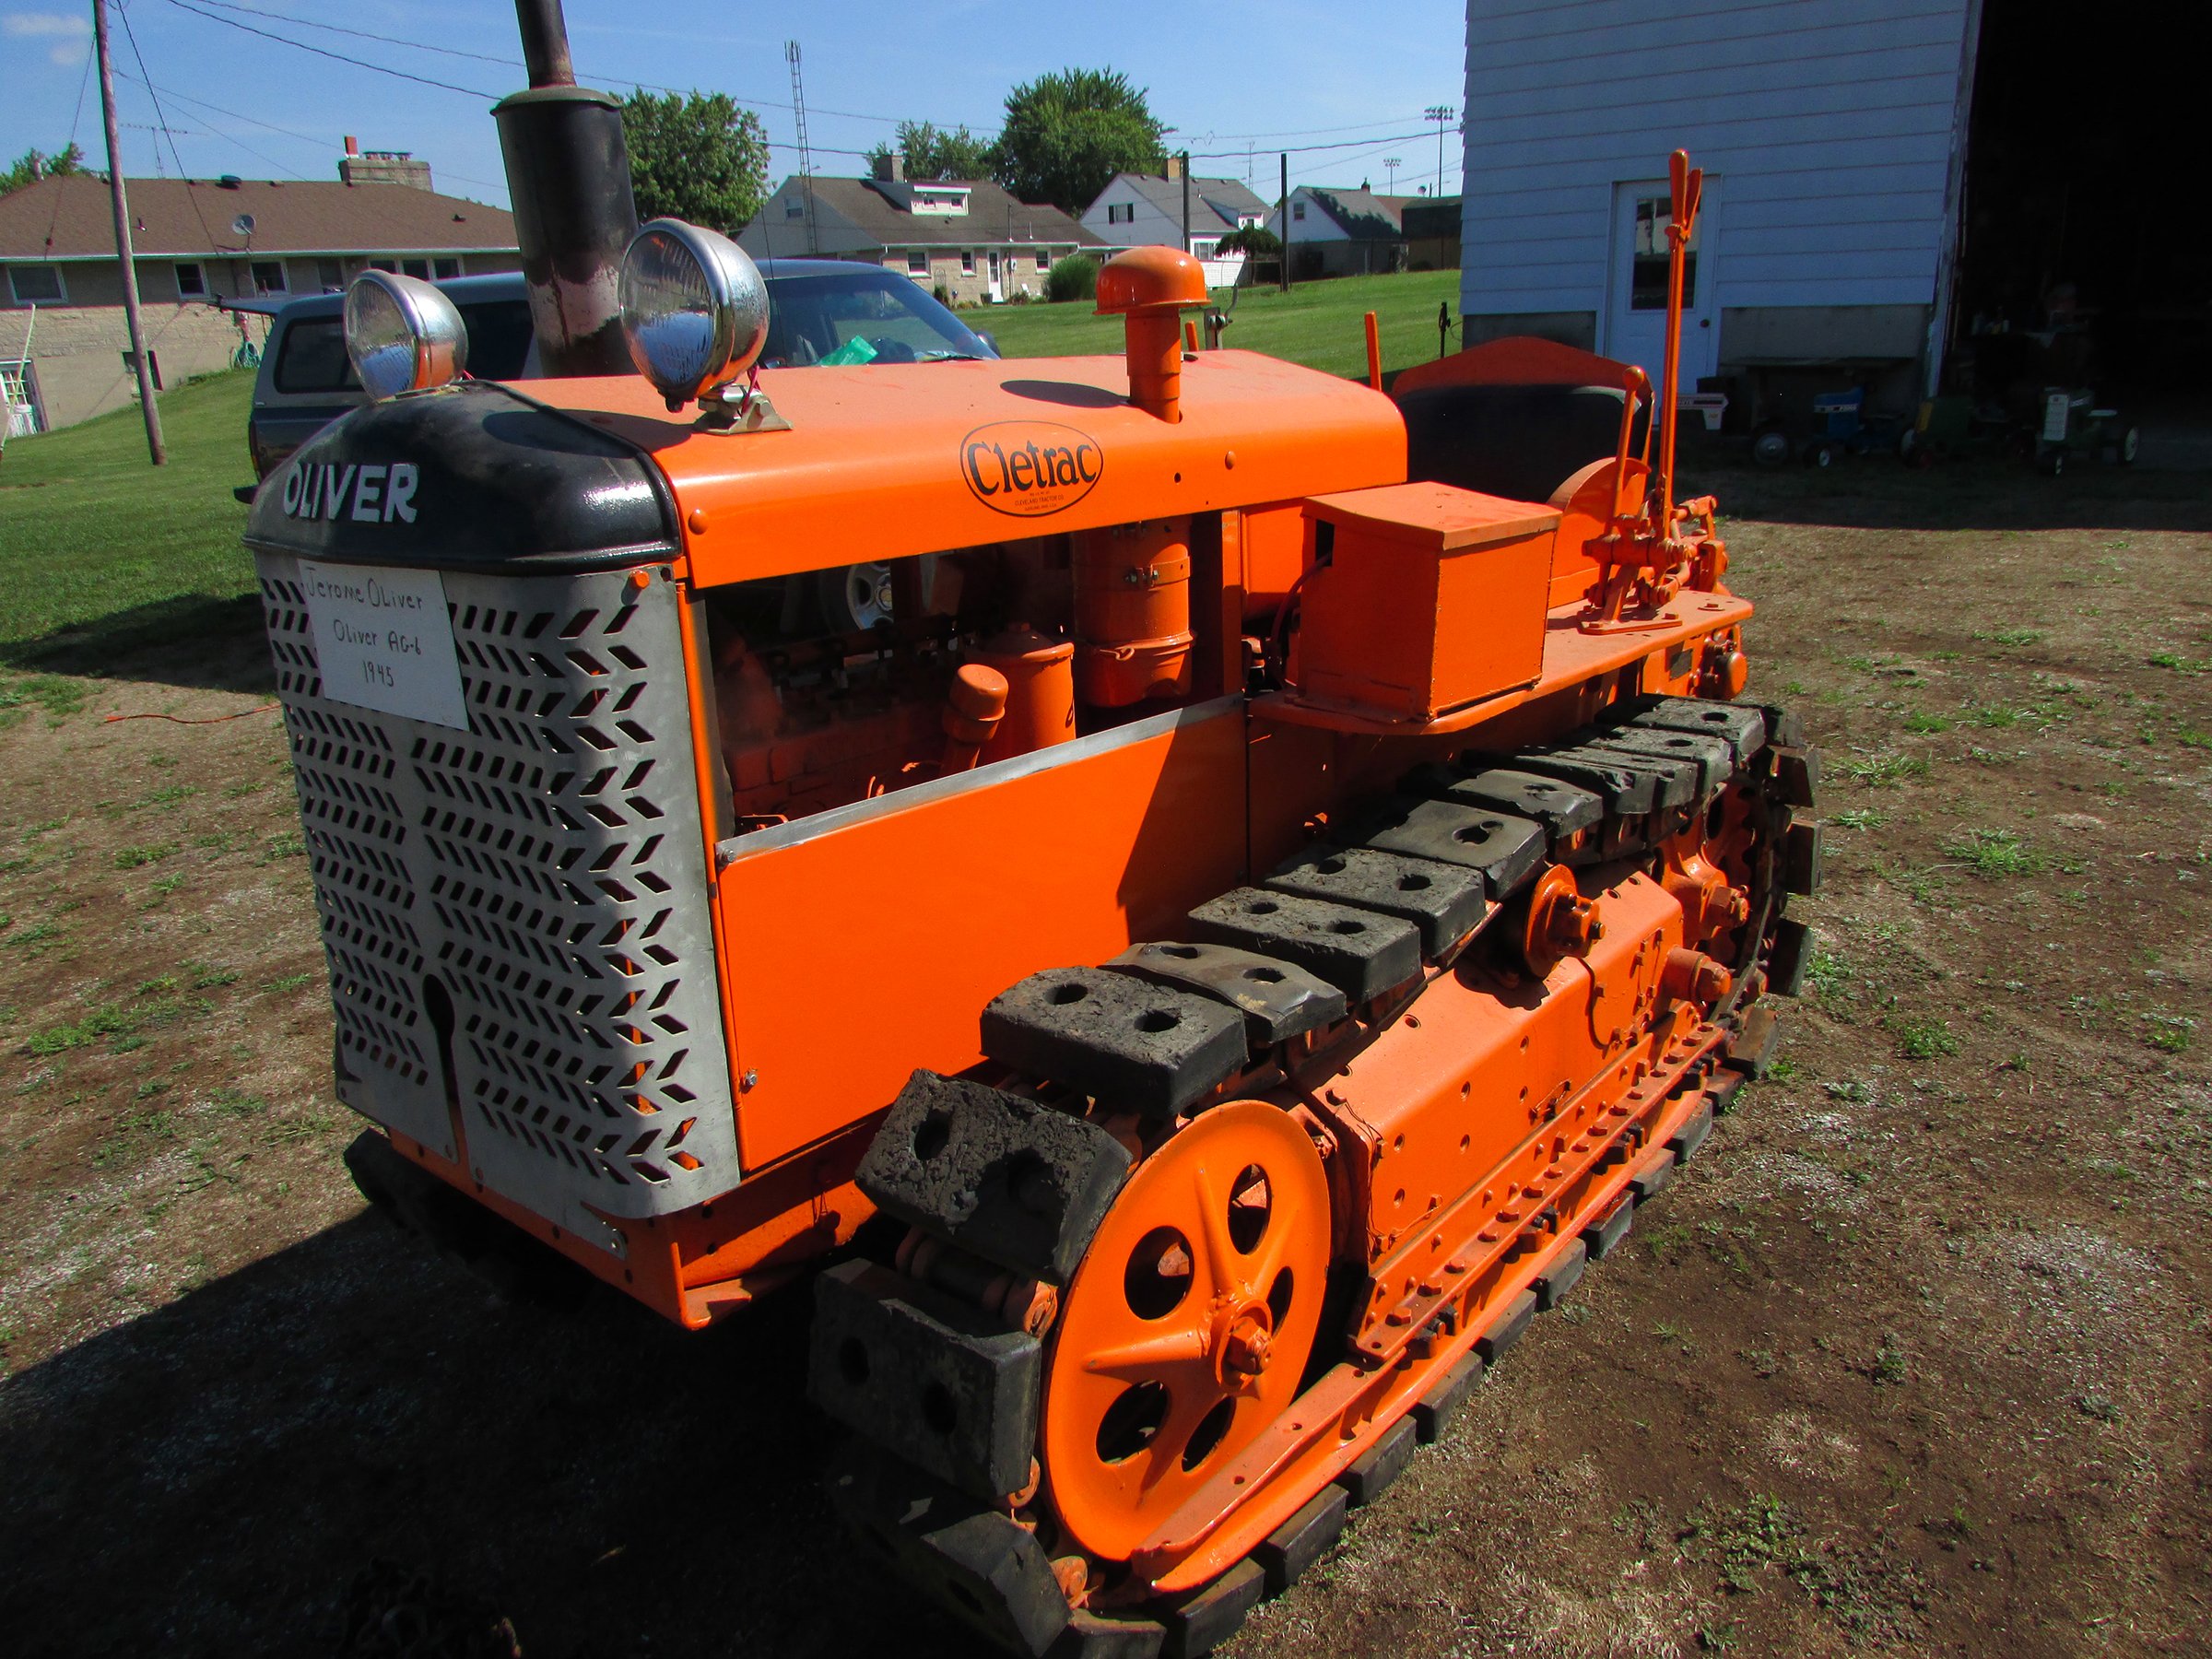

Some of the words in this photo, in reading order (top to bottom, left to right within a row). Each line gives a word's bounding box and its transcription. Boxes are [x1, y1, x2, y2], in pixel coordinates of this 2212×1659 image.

[967, 440, 1097, 496] Cletrac
[283, 461, 418, 524] OLIVER
[388, 630, 422, 655] AG-6
[362, 660, 394, 687] 1945
